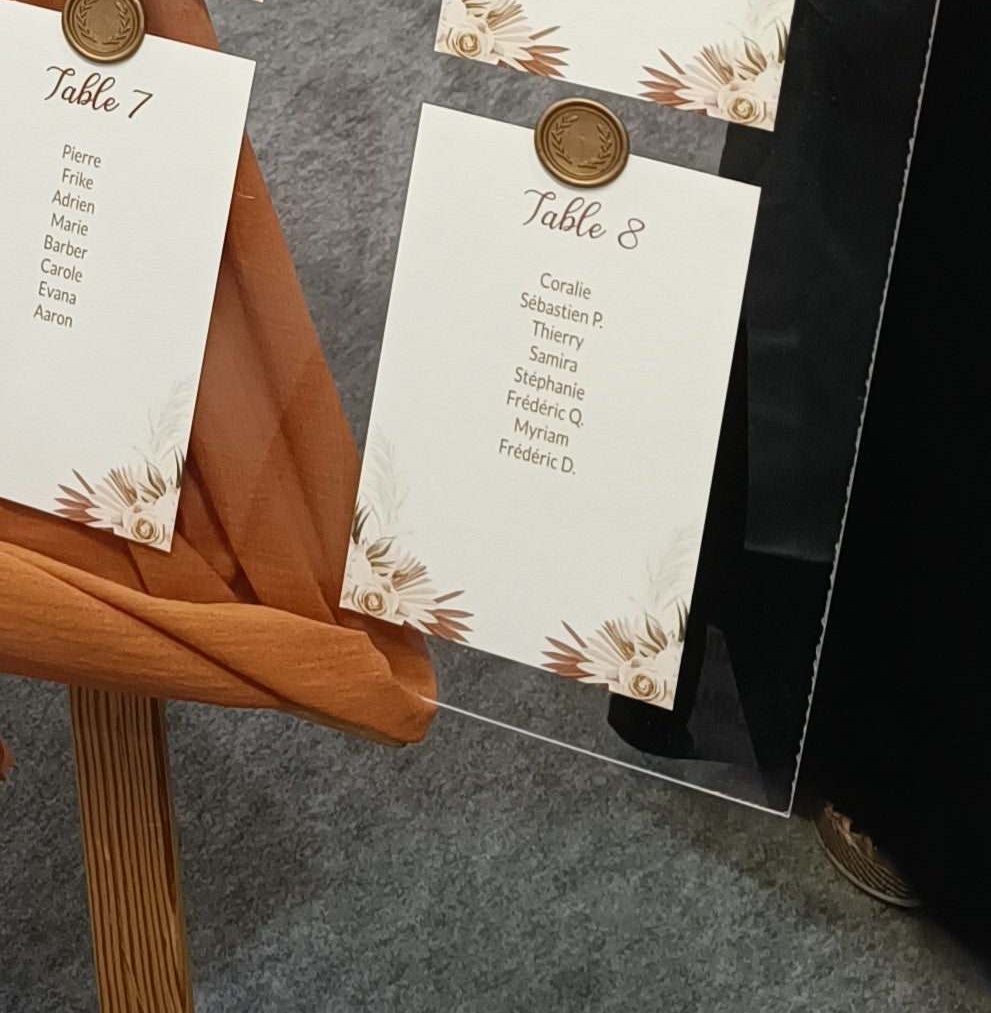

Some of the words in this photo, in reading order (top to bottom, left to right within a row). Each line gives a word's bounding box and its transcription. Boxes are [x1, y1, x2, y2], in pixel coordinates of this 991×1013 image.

[45, 66, 119, 112] Table
[128, 90, 153, 118] 7
[62, 144, 101, 168] Pierre
[62, 168, 93, 190] Frike
[52, 190, 95, 214] Adrien
[51, 213, 88, 236] Marie
[523, 190, 606, 239] Table
[618, 218, 645, 250] 8
[44, 235, 88, 259] Barber
[41, 258, 82, 282] Carole
[39, 281, 76, 304] Evana
[540, 273, 592, 299] Coralie
[33, 304, 72, 328] Aaron
[520, 292, 588, 324] Sébastien
[592, 312, 603, 328] P.
[532, 320, 584, 351] Thierry
[529, 346, 578, 372] Samira
[514, 367, 585, 400] Stéphanie
[507, 390, 565, 420] Frédéric
[569, 408, 584, 428] Q.
[514, 418, 569, 447] Myriam
[499, 439, 557, 470] Frédéric
[561, 457, 576, 474] D.
